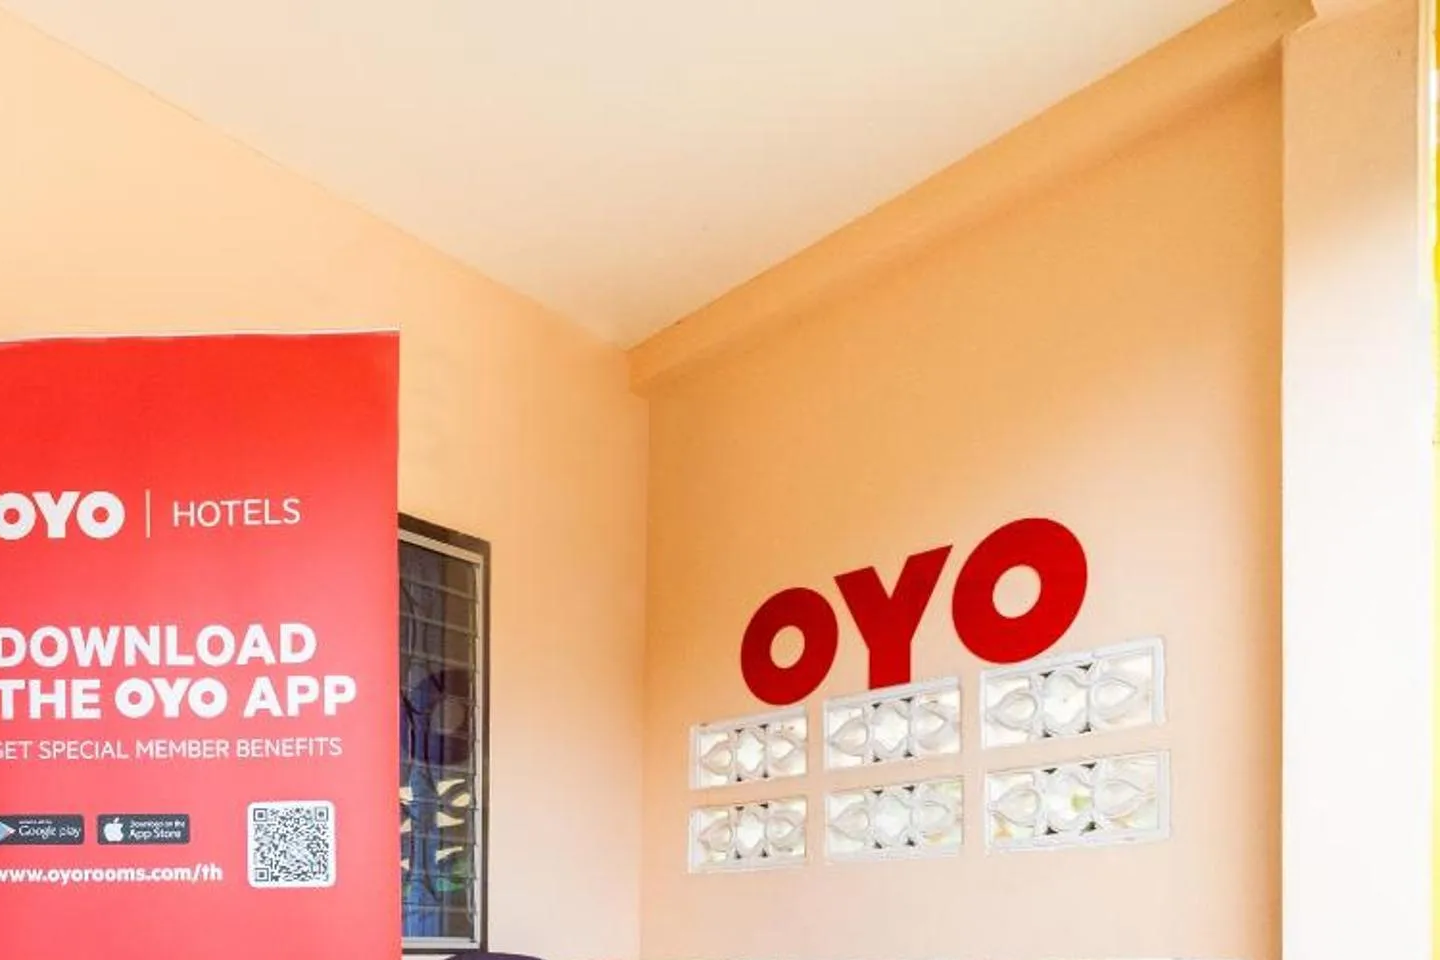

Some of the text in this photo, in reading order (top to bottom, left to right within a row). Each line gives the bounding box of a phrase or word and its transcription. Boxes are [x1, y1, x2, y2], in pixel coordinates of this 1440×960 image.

[172, 497, 302, 528] HOTELS
[740, 517, 1088, 706] OYO
[114, 676, 229, 720] OYO
[242, 674, 358, 719] APP
[37, 739, 129, 760] SPECIAL
[135, 738, 231, 759] MEMBER
[236, 736, 343, 758] BENEFITS
[18, 824, 57, 840] Google
[129, 828, 182, 841] App Store
